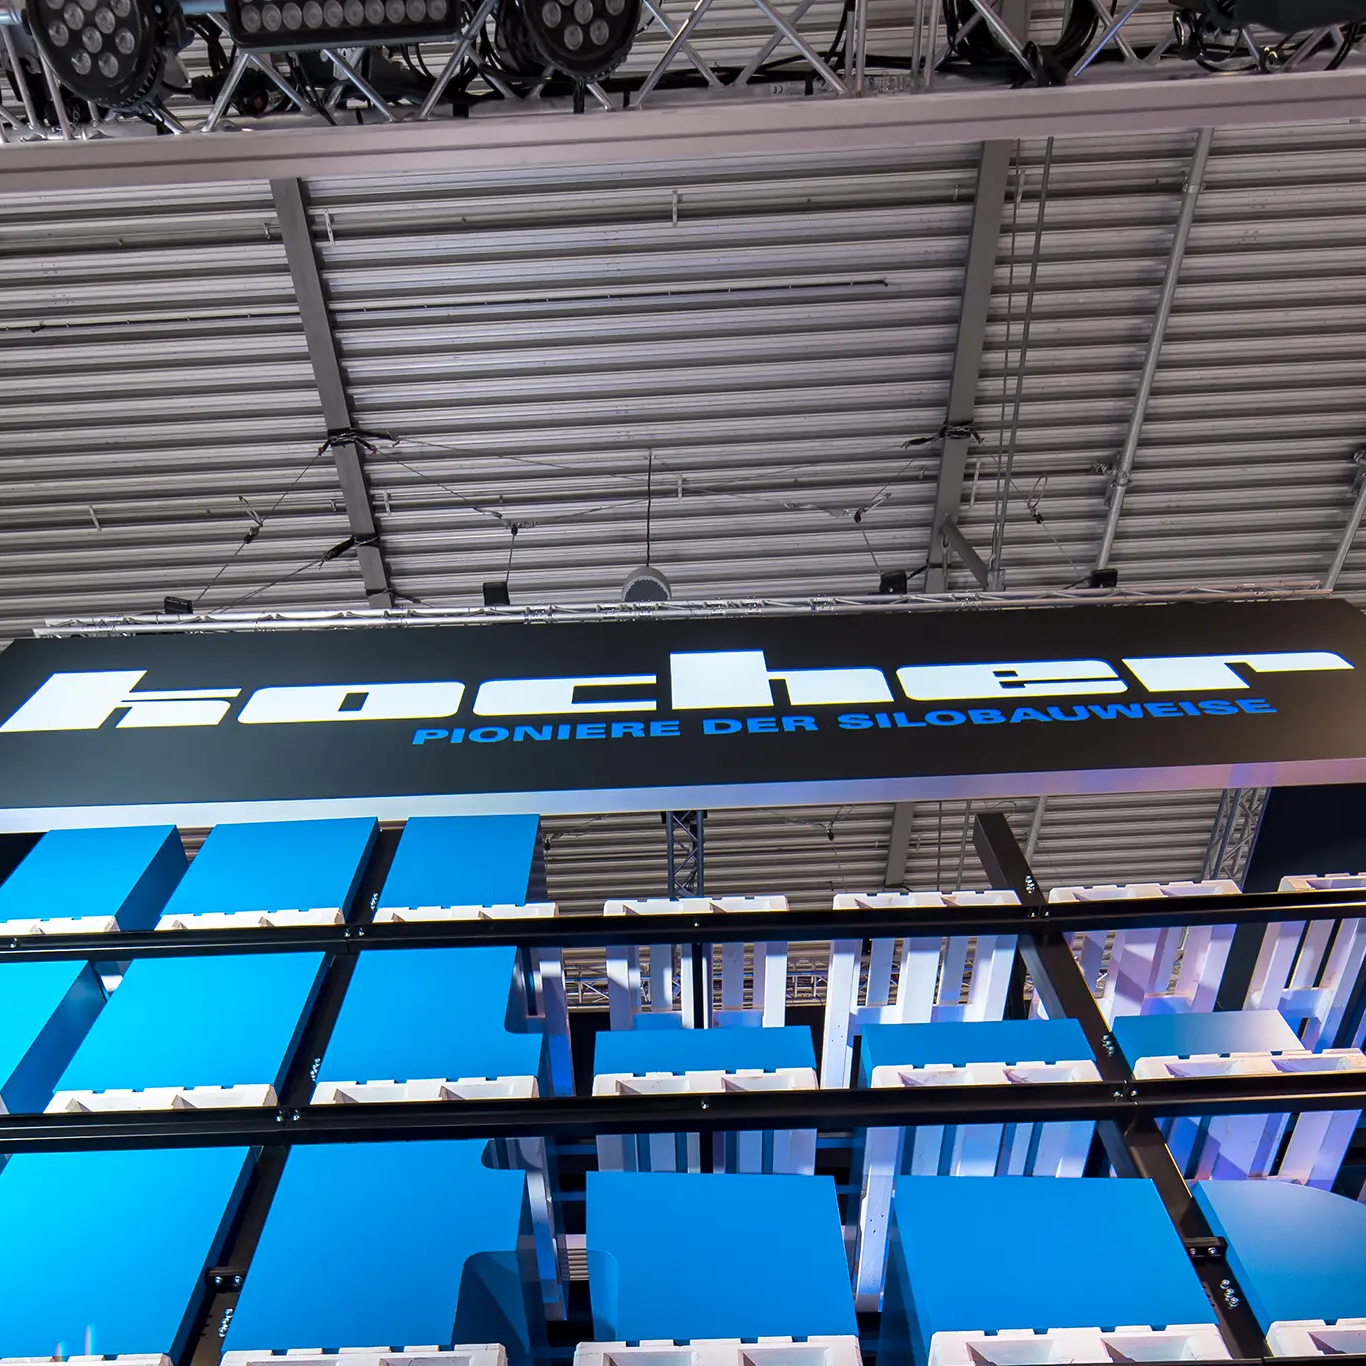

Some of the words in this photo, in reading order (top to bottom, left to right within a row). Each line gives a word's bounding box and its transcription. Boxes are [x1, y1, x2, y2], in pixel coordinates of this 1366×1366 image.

[410, 720, 680, 745] PIONIERE
[702, 714, 819, 735] DER
[837, 698, 1277, 730] SILOBAUWEISE
